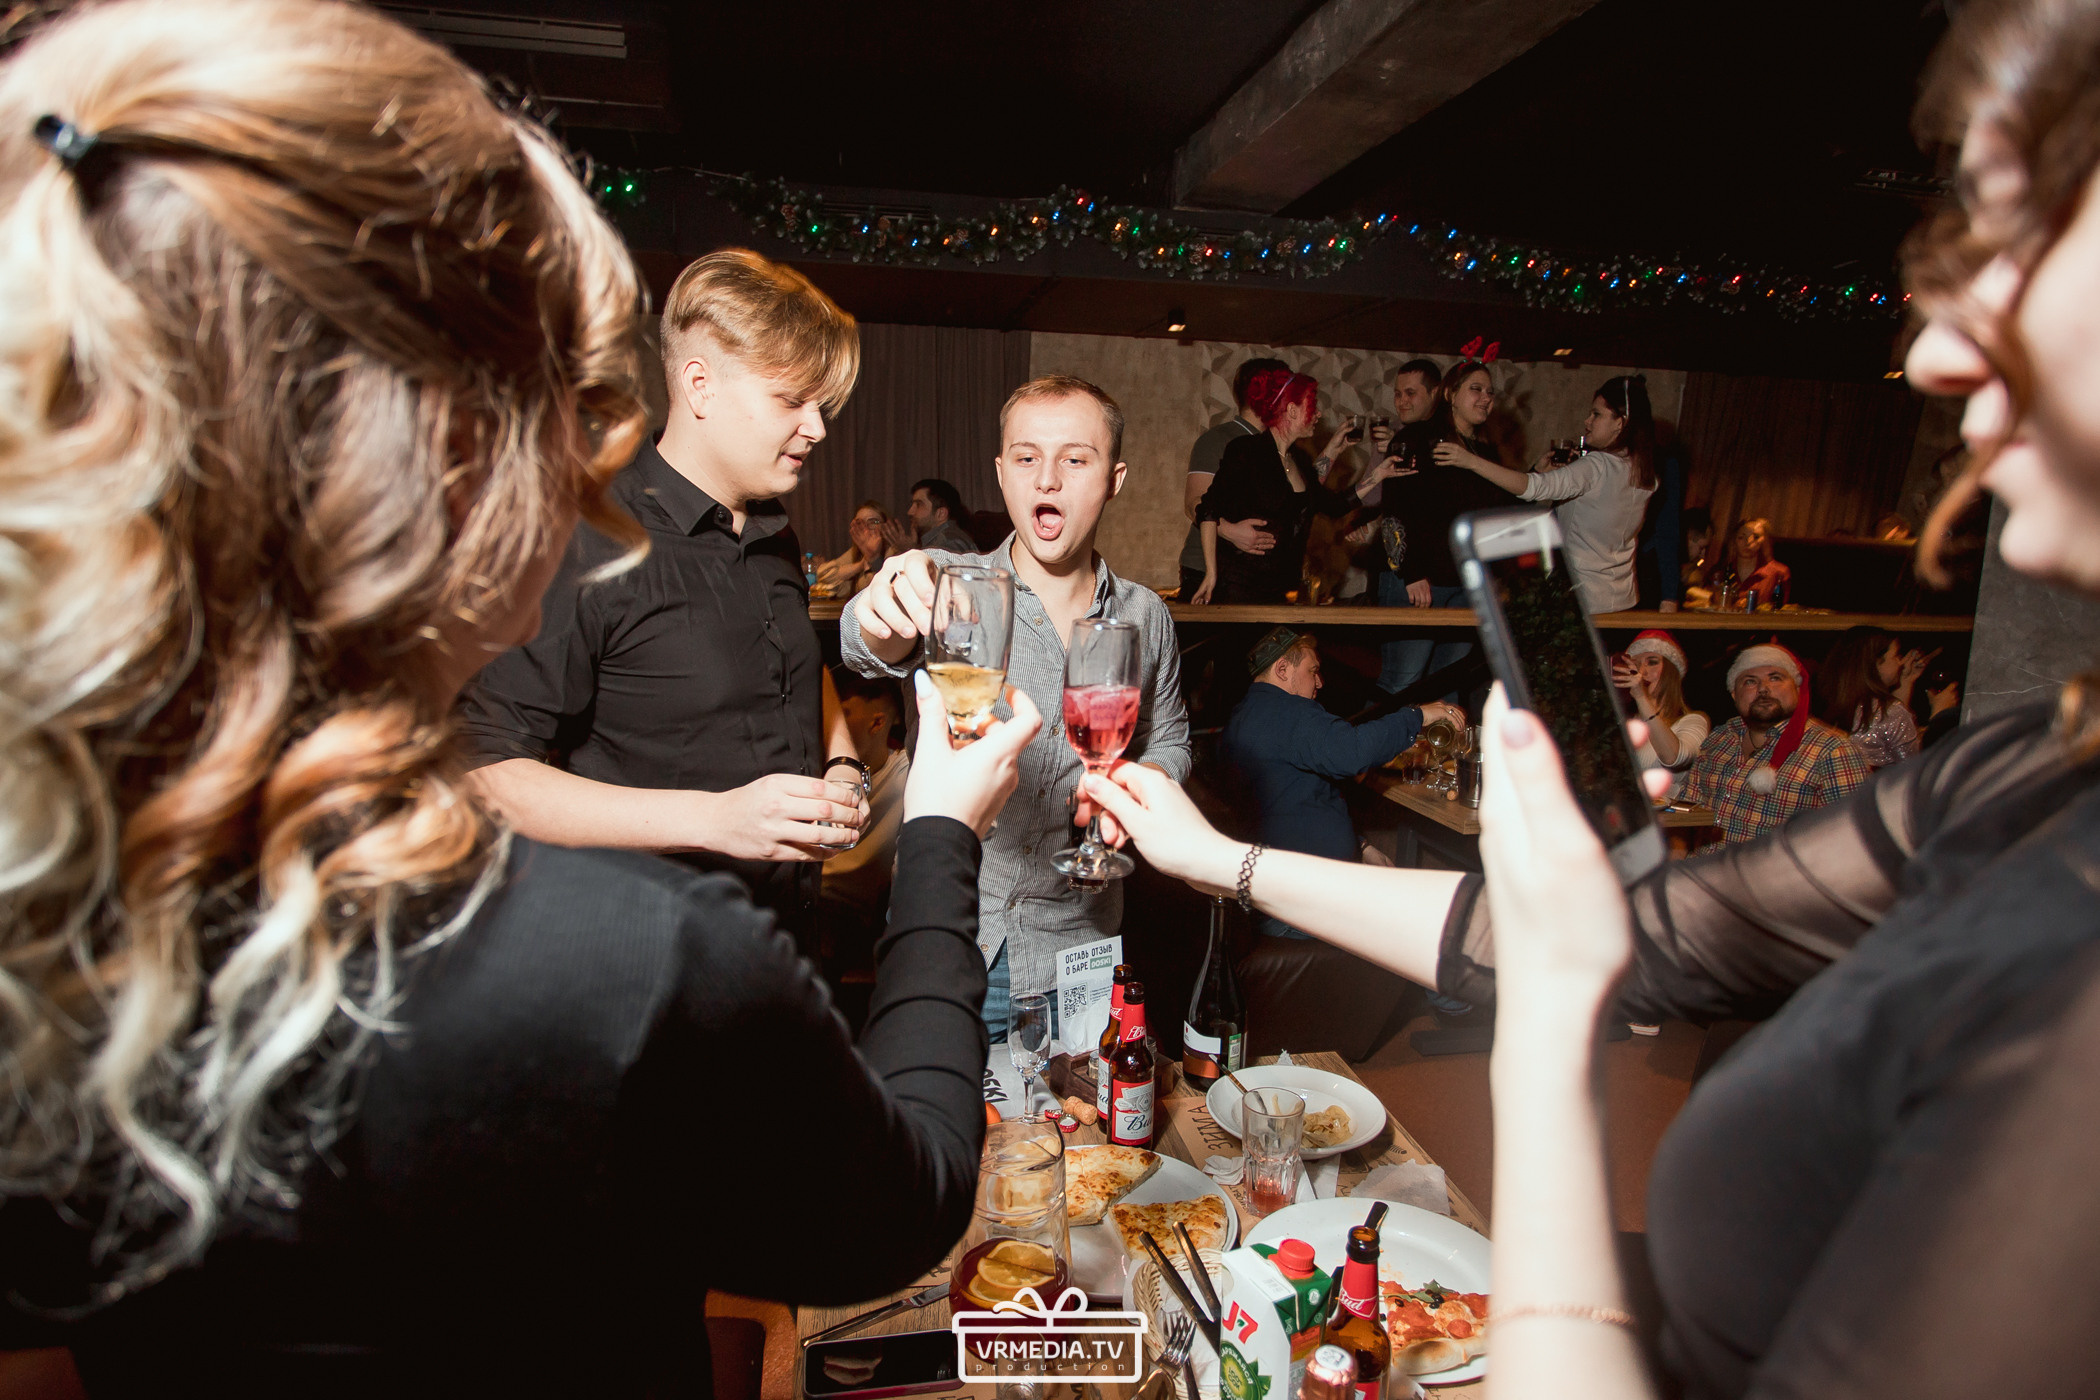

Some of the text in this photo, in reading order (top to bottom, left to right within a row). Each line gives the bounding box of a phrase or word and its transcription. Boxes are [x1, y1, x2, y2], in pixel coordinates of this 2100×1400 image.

[1065, 943, 1113, 964] ОСТАВЬ ОТЗЫВ
[1065, 957, 1112, 976] О БАРЕ DOSKI
[1124, 1114, 1152, 1131] Bu
